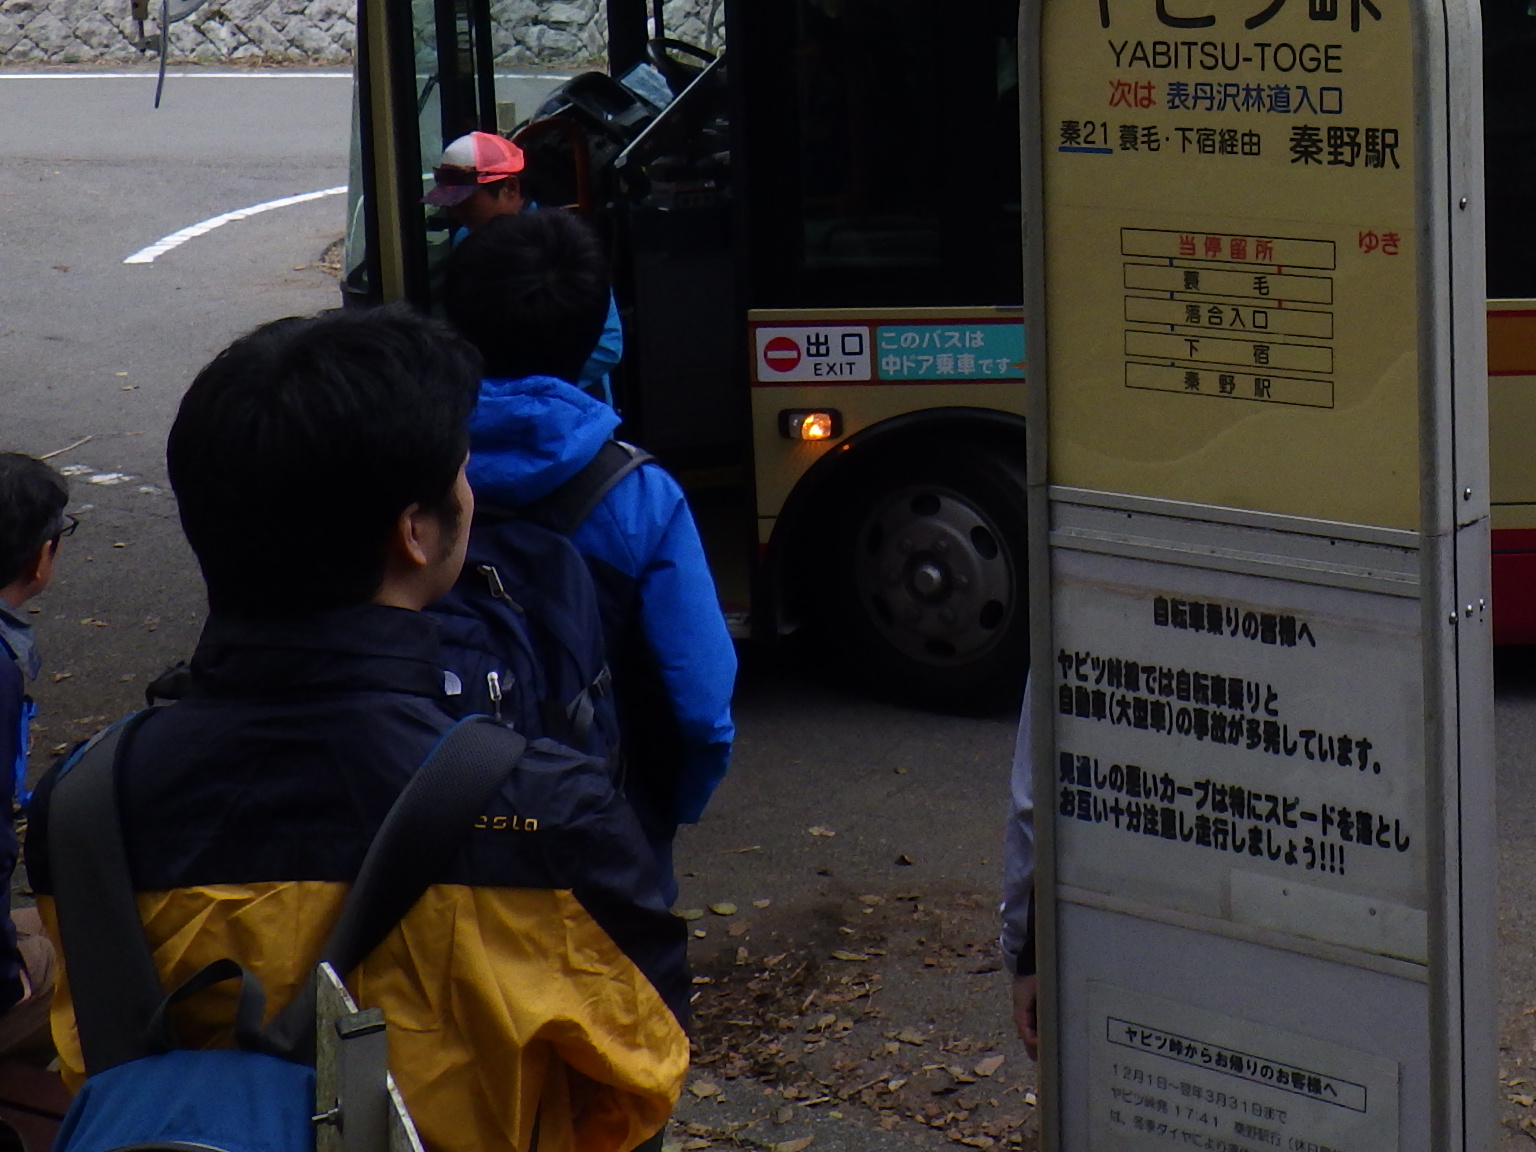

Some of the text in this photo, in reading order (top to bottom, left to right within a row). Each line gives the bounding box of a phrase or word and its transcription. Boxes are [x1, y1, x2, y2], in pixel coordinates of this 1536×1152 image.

[1108, 40, 1343, 73] YABITSU-TOGE
[1108, 79, 1343, 114] 次は 表丹沢林道入口
[1289, 124, 1400, 169] 秦野駅
[1179, 234, 1274, 262] 当停留所
[1358, 230, 1400, 256] ゆき
[806, 333, 863, 357] 出口
[882, 331, 985, 349] このバスは
[814, 362, 856, 376] EXIT
[882, 353, 1011, 375] 中ドア乗車です
